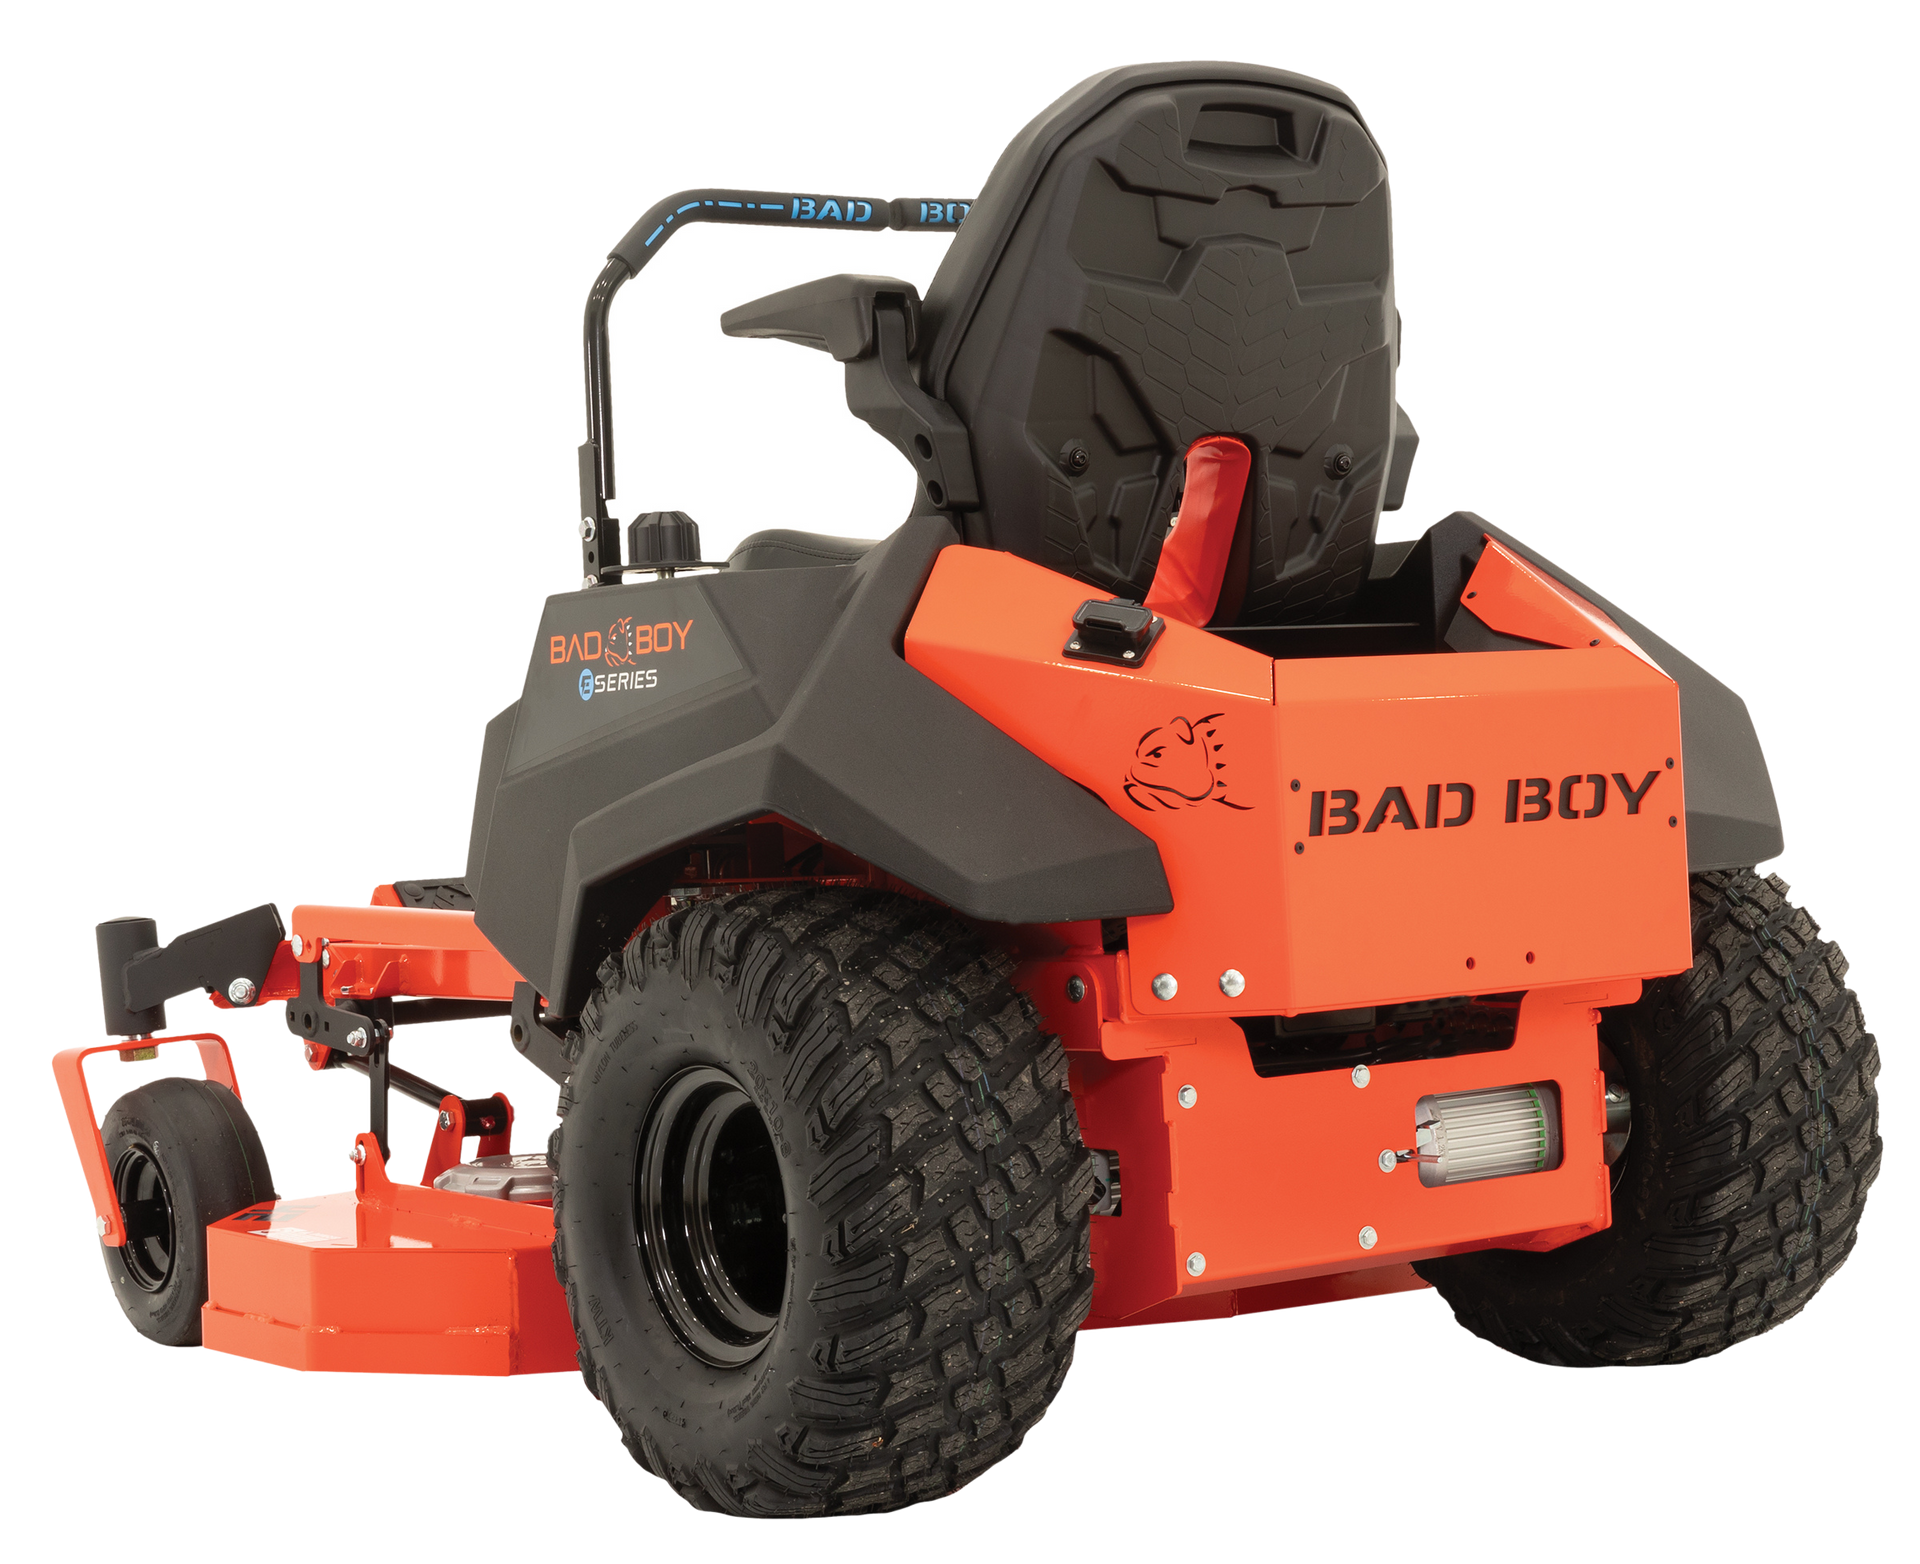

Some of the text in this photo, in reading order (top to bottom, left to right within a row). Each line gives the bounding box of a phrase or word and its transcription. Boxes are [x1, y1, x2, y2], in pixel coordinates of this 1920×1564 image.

[791, 197, 872, 222] BAD
[550, 619, 693, 664] BAD BOY
[594, 669, 658, 693] SERIES
[1308, 770, 1663, 837] BAD BOY
